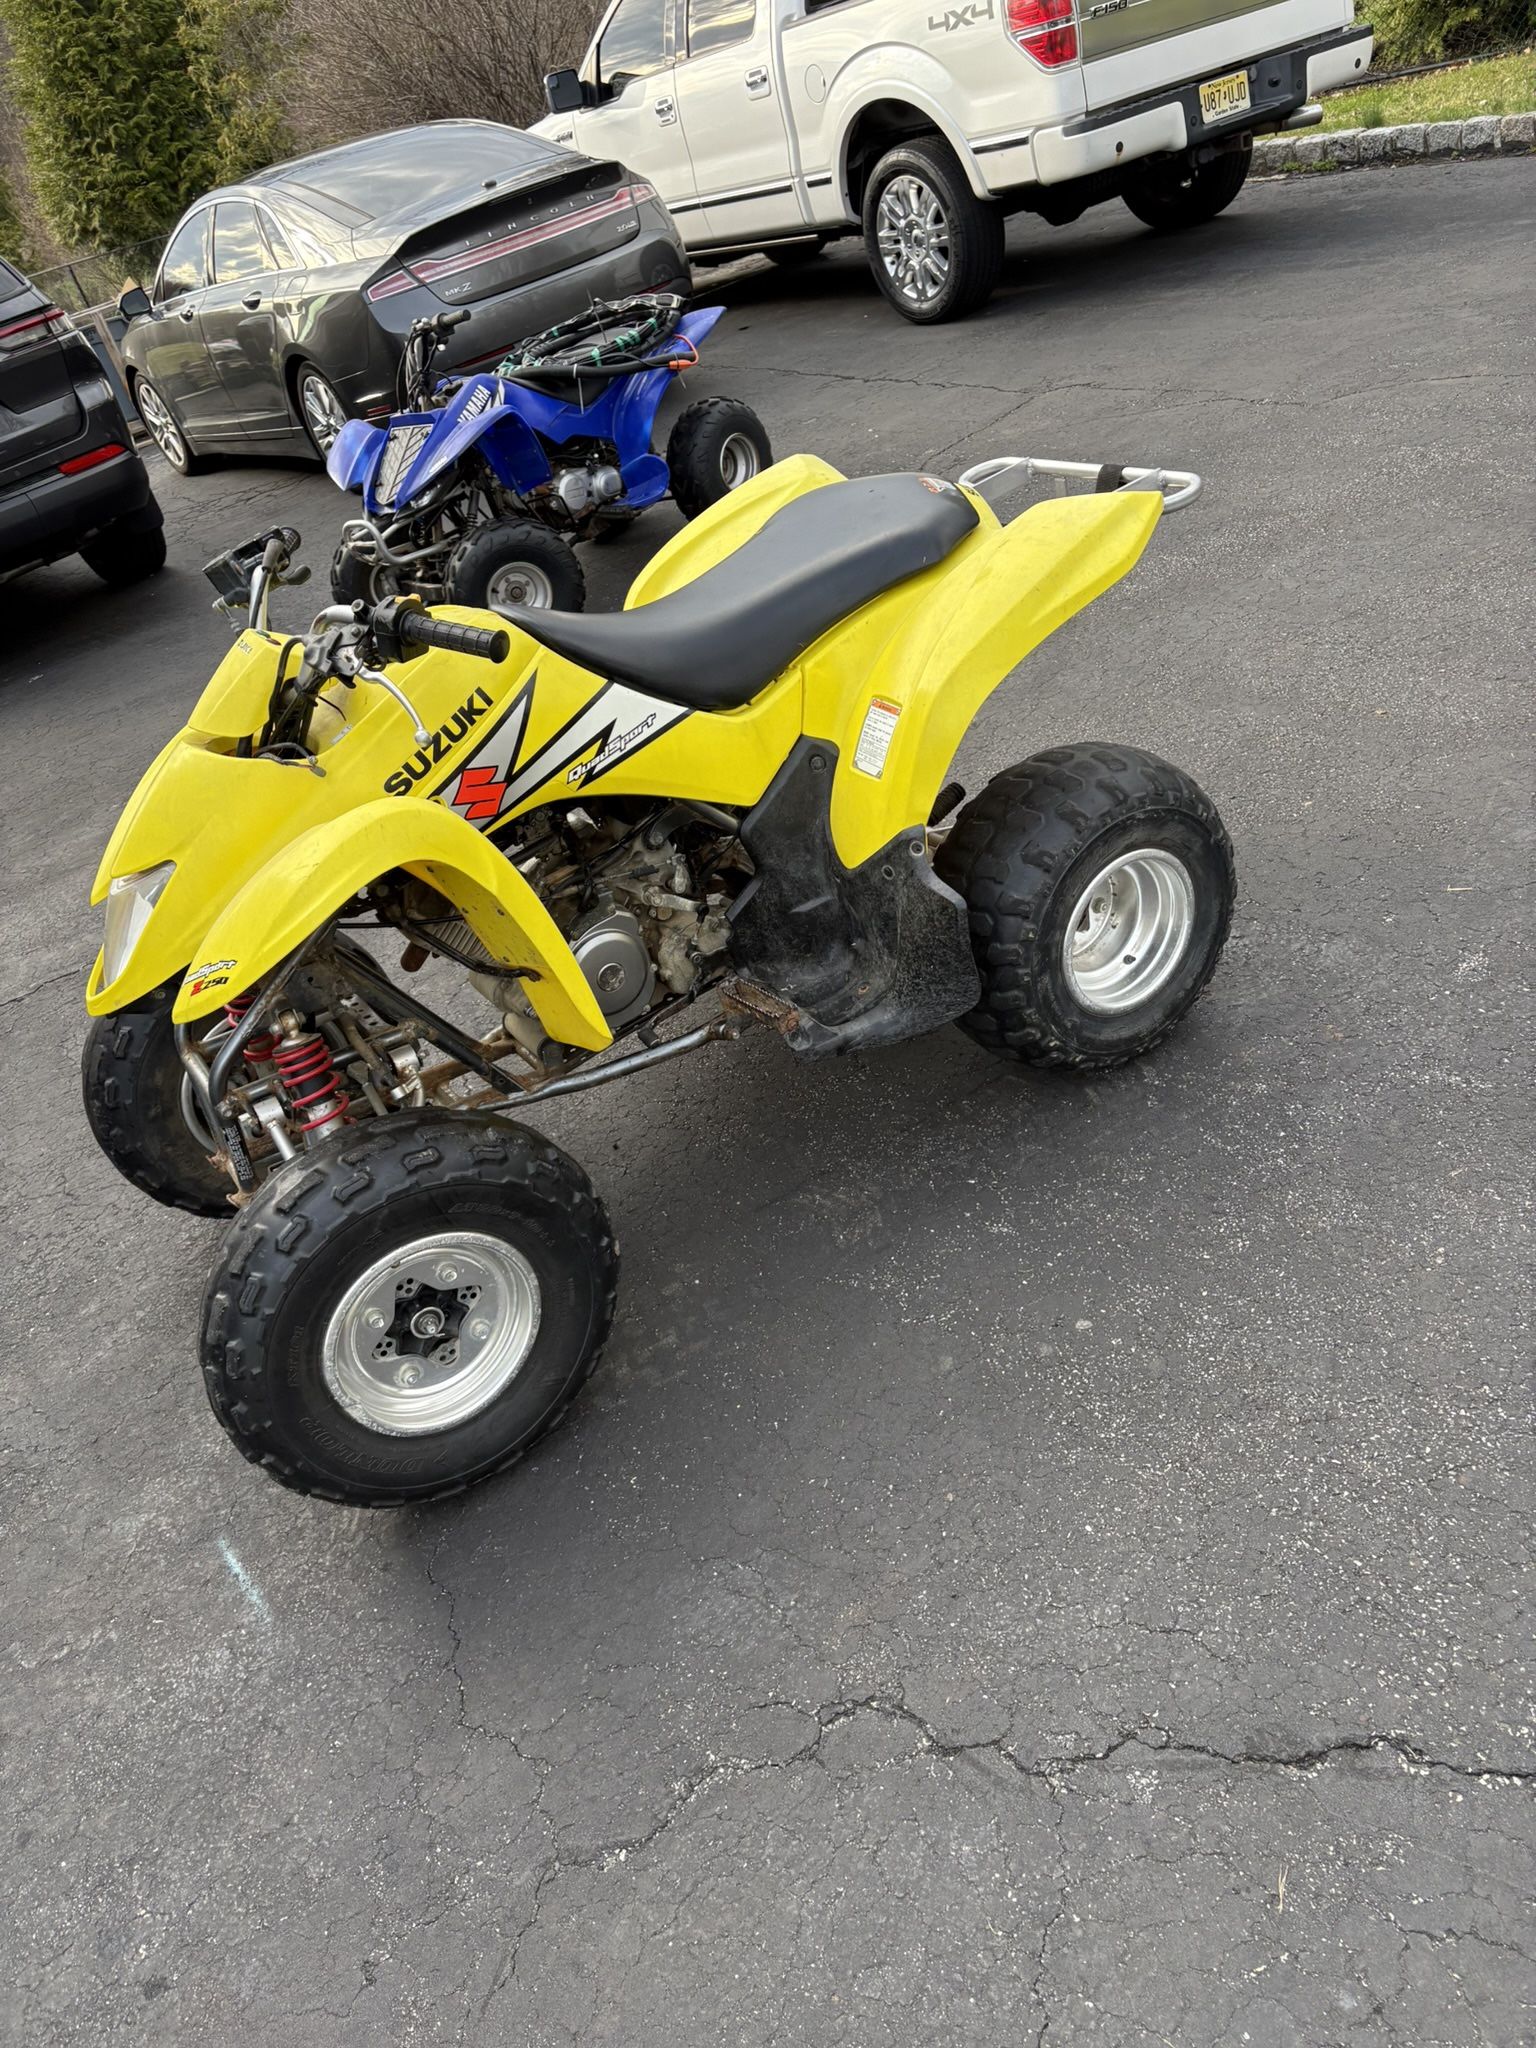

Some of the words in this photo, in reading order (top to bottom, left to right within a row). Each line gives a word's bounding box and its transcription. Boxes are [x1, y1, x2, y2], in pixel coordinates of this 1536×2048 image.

[465, 194, 594, 246] LINCOLN
[457, 384, 491, 423] YAMAHA
[383, 686, 494, 796] SUZUKI
[566, 712, 657, 785] QuadSport
